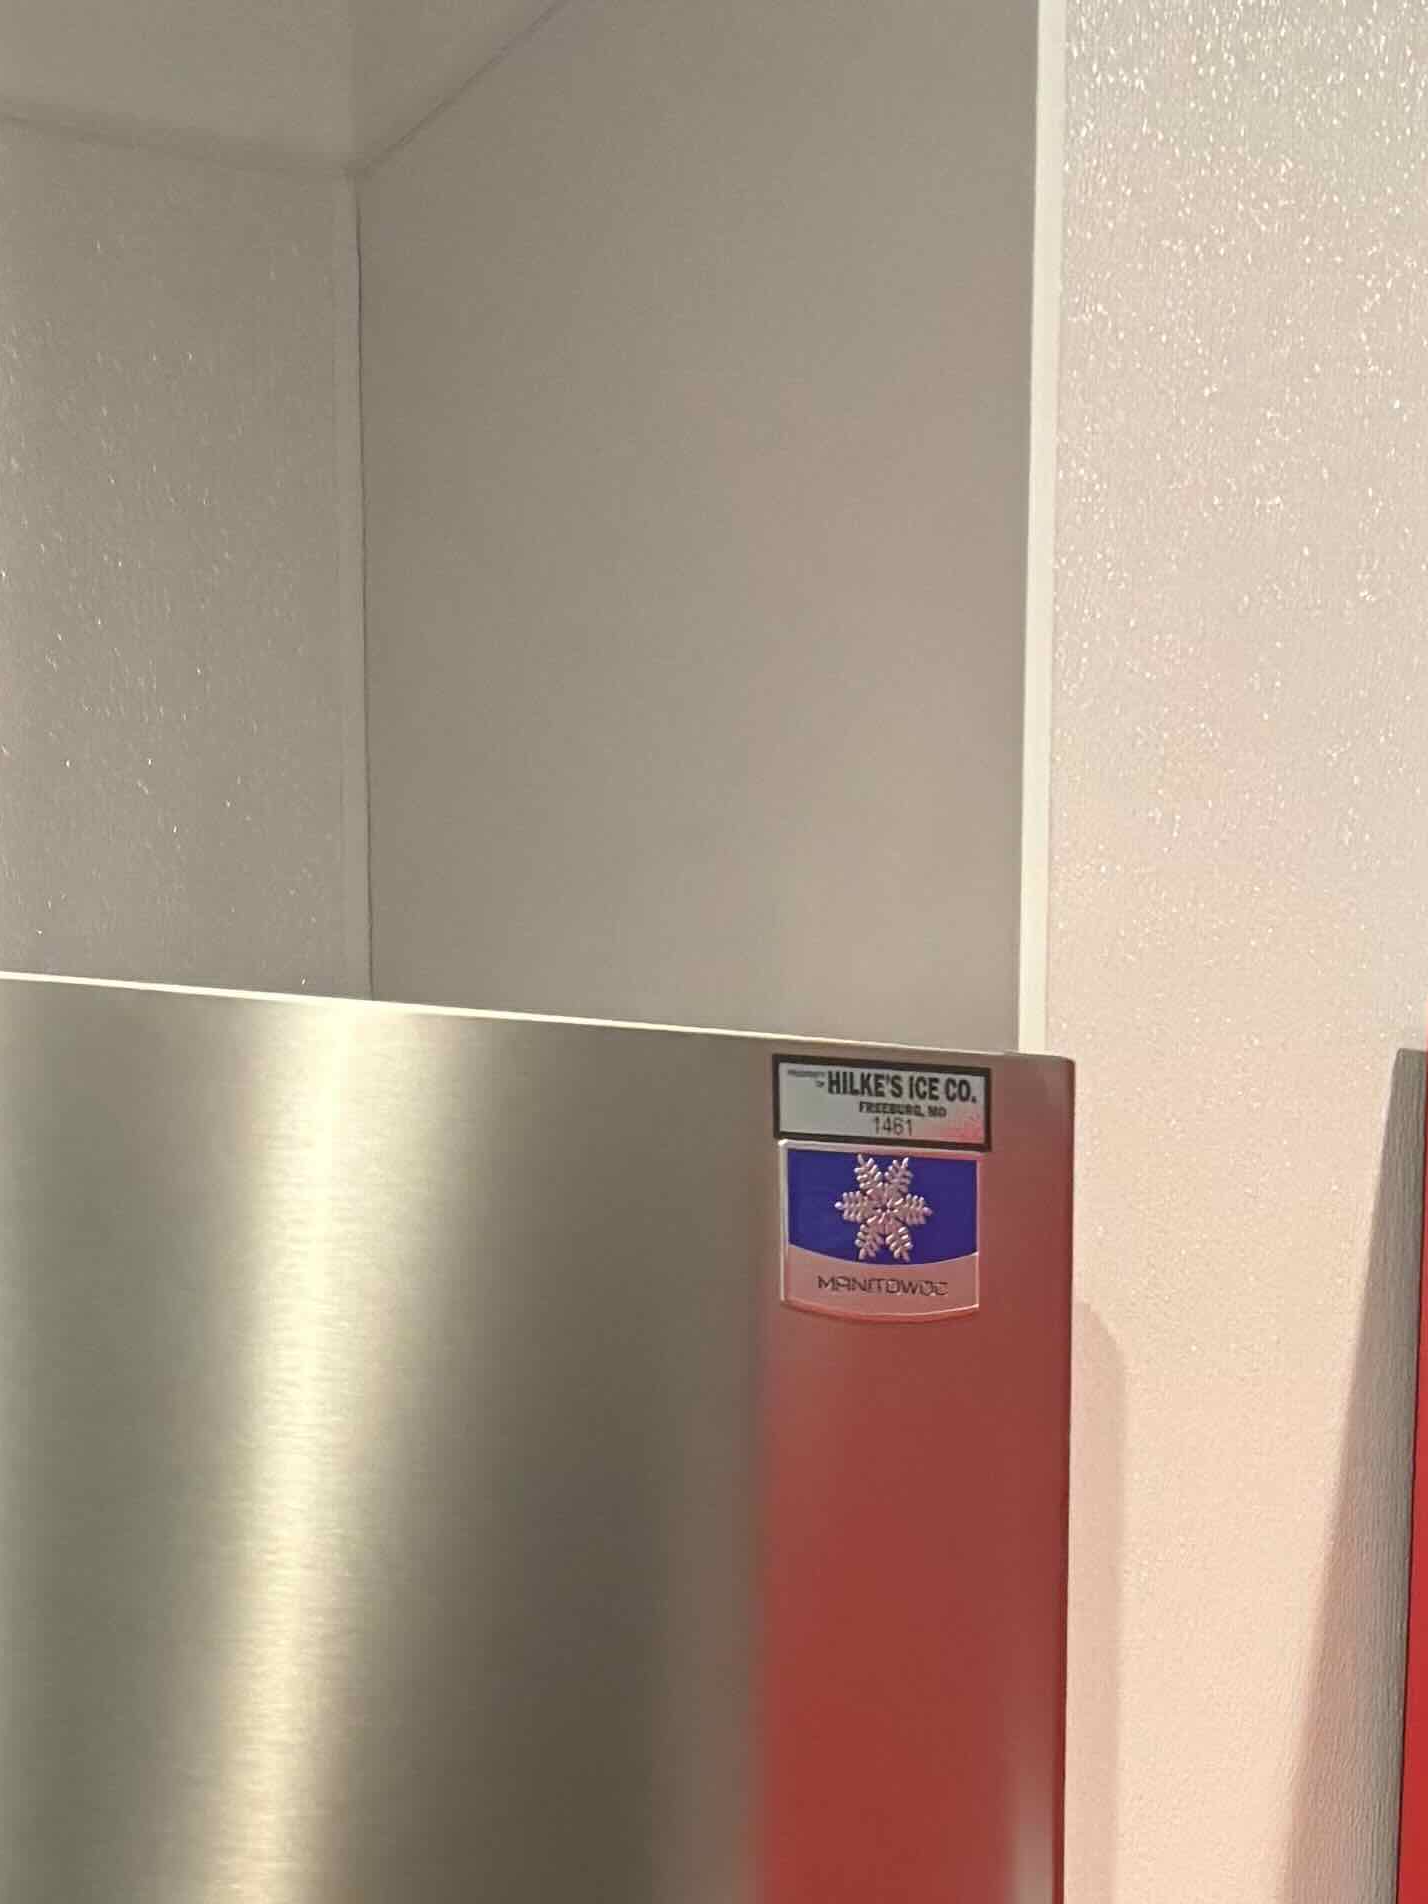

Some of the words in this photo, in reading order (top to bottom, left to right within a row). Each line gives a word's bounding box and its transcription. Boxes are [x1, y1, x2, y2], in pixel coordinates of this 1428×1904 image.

[827, 1070, 903, 1098] HILKE'S
[908, 1075, 940, 1101] ICE
[944, 1078, 978, 1105] CO.
[873, 1117, 914, 1137] 1461
[817, 1274, 949, 1297] MANITOWOC
